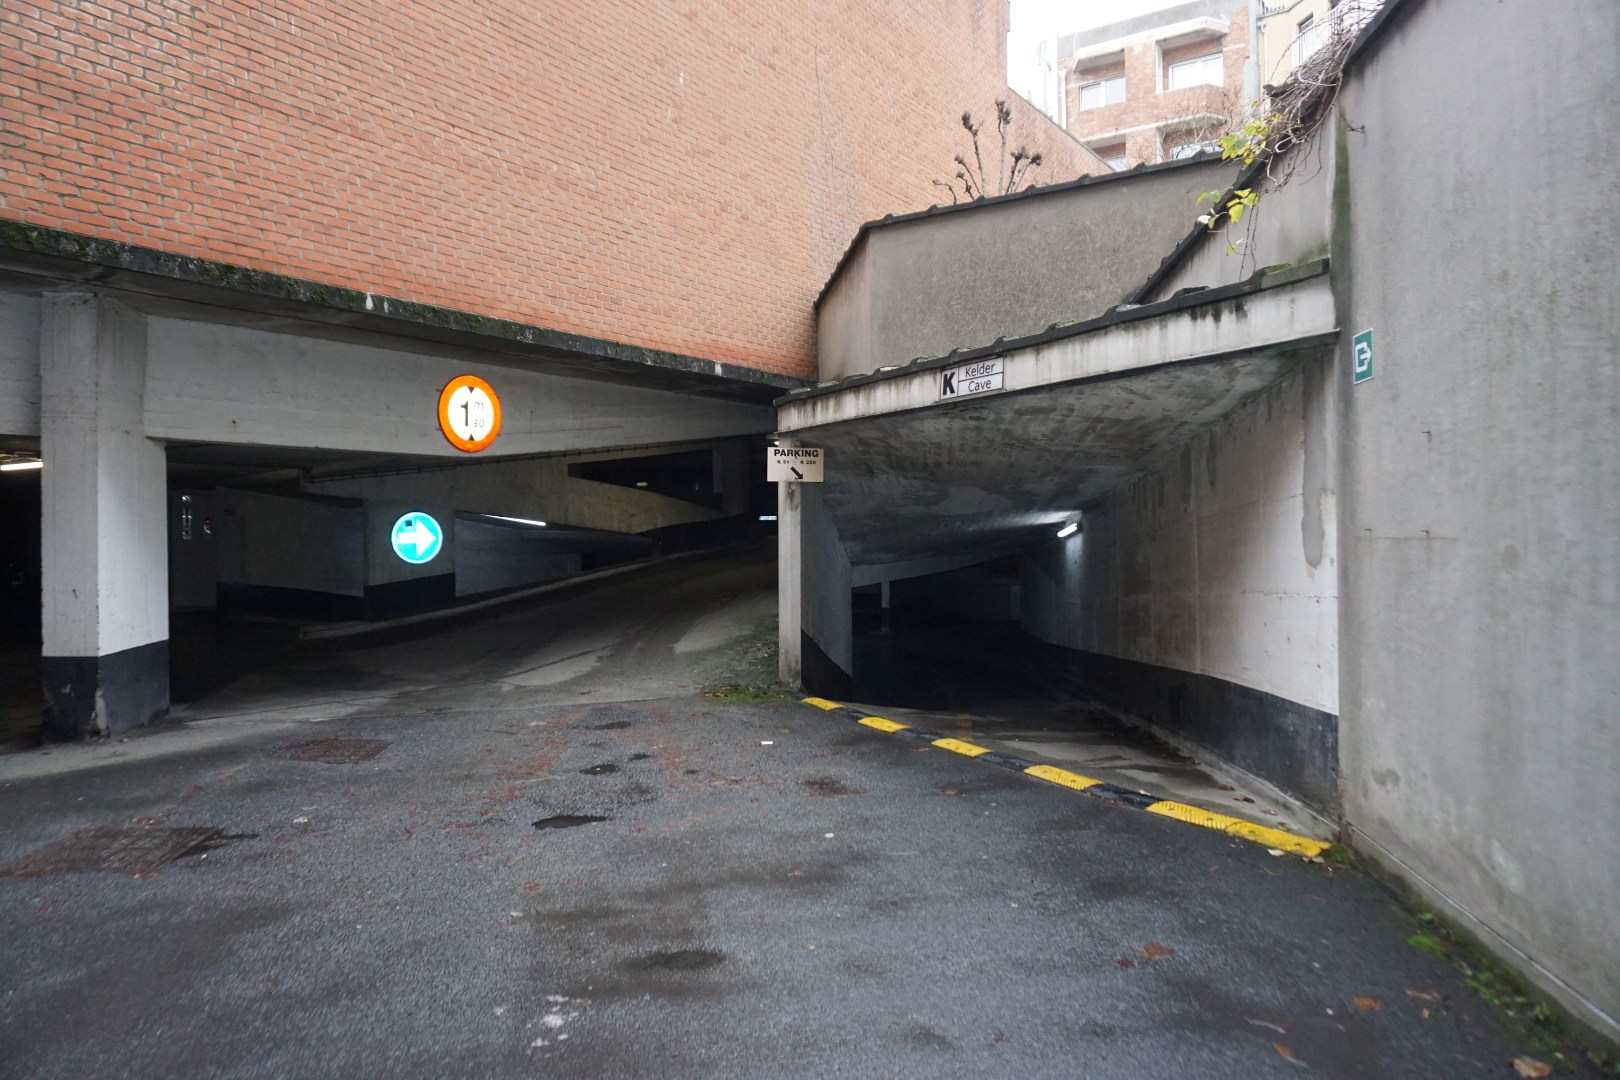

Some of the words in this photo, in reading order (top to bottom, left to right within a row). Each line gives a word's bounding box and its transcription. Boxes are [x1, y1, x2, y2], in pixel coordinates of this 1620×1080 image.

[965, 362, 996, 378] Kelder
[942, 372, 956, 396] K
[968, 379, 992, 392] Cave
[460, 400, 469, 427] 1
[473, 401, 484, 412] m
[473, 418, 485, 429] 90
[774, 449, 819, 458] PARKING
